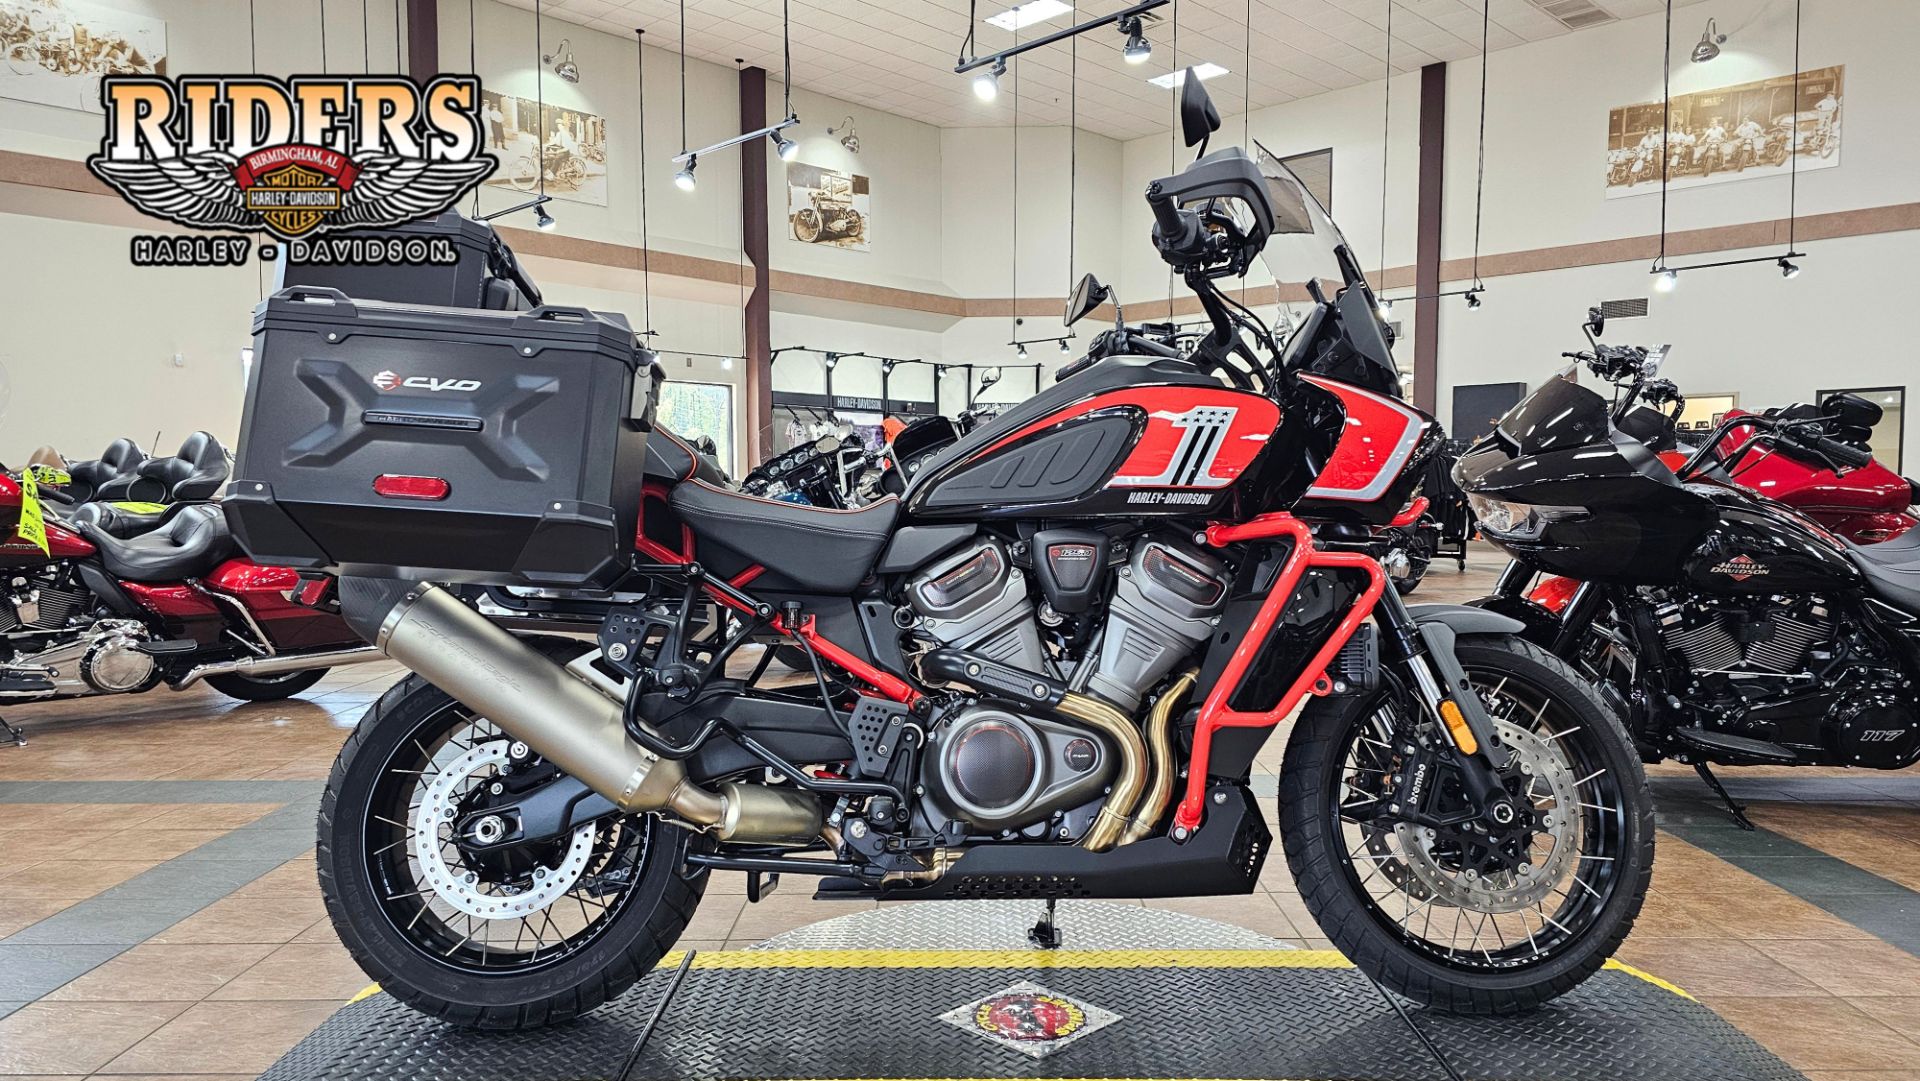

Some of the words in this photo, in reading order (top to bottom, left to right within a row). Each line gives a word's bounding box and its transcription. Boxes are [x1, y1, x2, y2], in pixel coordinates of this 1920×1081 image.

[402, 376, 482, 392] CVO
[837, 397, 882, 410] HARLEY-DAVIDSON
[1126, 491, 1213, 506] HARLEY-DAVIDSON
[1709, 566, 1770, 575] DAVIDSON
[1860, 729, 1906, 741] 117
[1407, 763, 1427, 804] brembo
